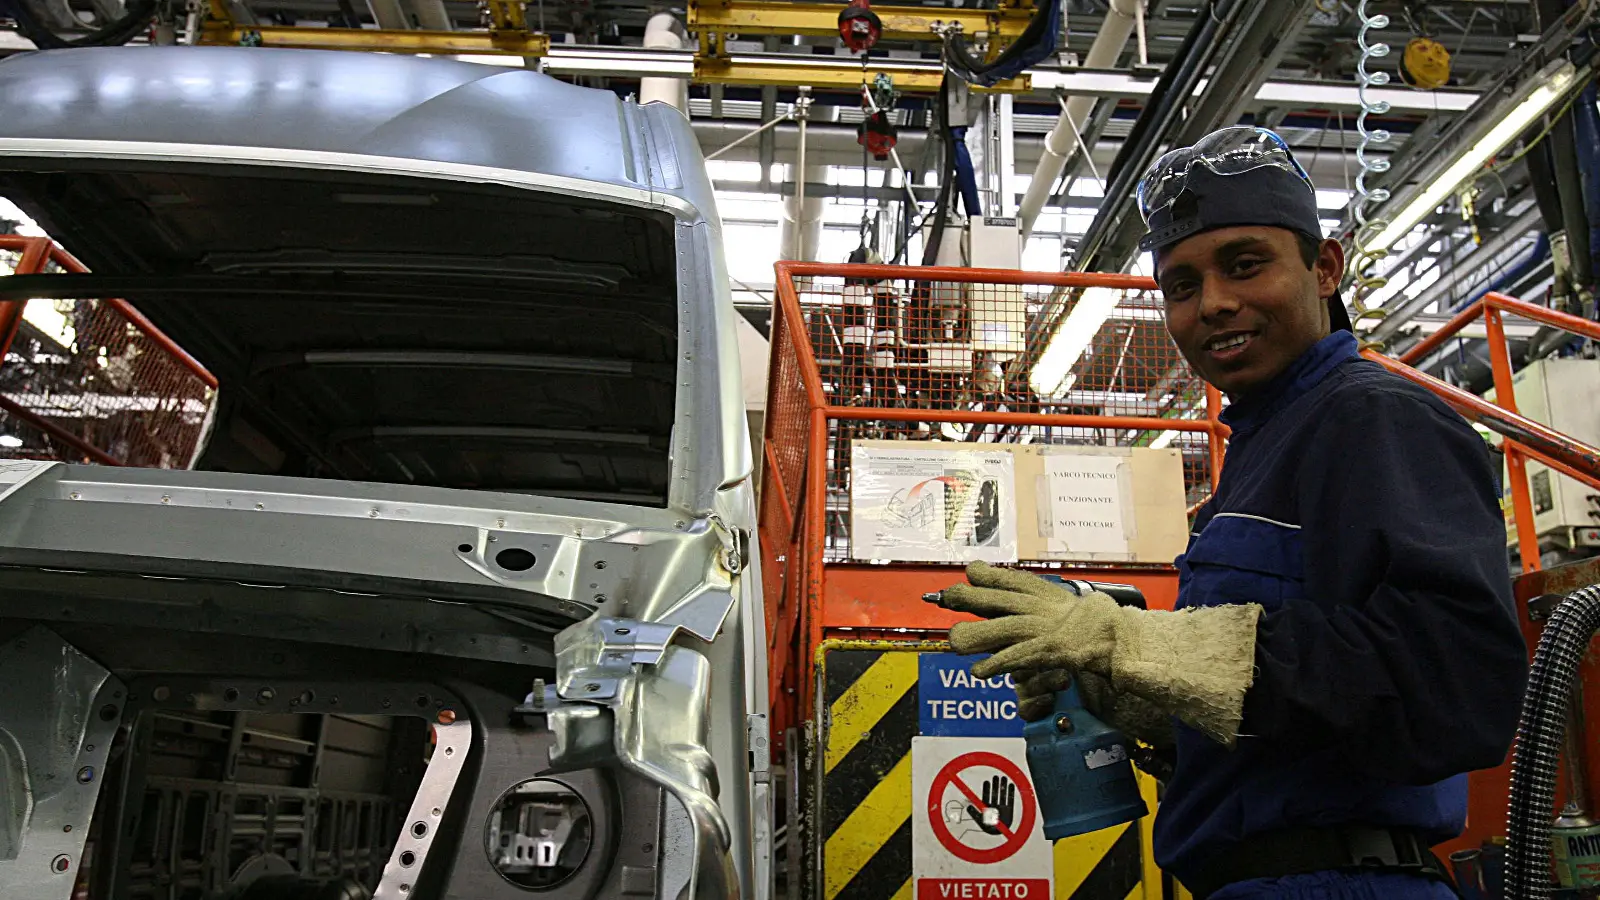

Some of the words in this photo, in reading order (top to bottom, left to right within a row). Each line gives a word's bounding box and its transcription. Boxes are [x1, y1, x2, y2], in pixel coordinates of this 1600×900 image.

[1058, 495, 1114, 503] FUNZIONANTE
[1078, 520, 1115, 528] TOCCARE
[927, 699, 1017, 720] TECNIC
[939, 883, 1029, 899] VIETATO
